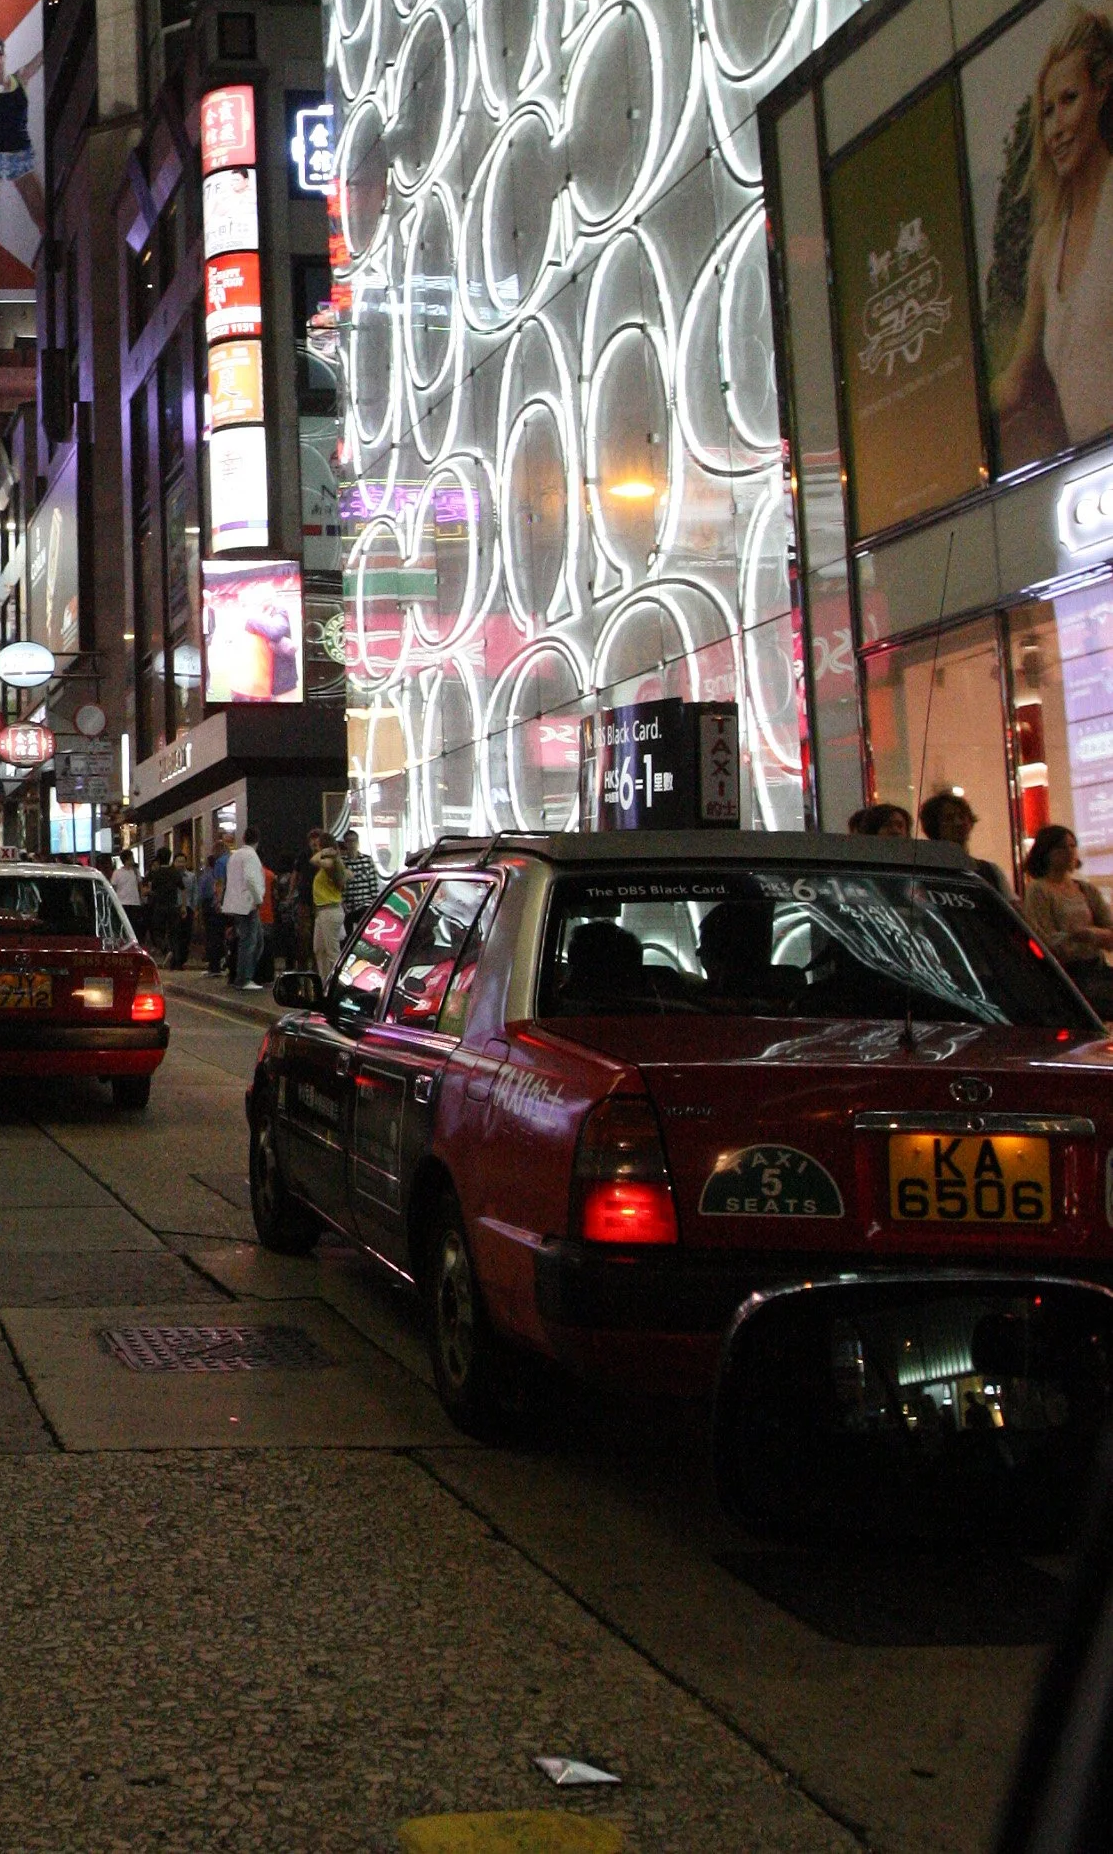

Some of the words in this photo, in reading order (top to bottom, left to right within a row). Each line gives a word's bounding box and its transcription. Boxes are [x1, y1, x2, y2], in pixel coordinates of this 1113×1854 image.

[607, 720, 631, 746] Black
[633, 716, 662, 742] Card.
[711, 717, 732, 797] TAXI
[706, 801, 737, 816] 的士
[586, 886, 616, 898] The
[618, 885, 646, 898] DBS
[650, 883, 688, 896] Black
[692, 882, 730, 896] Card.
[926, 890, 976, 910] DBS
[717, 1148, 808, 1176] TAXI
[933, 1137, 1004, 1179] KA
[760, 1168, 784, 1196] 5
[725, 1198, 818, 1214] SEATS
[897, 1178, 1045, 1221] 6506
